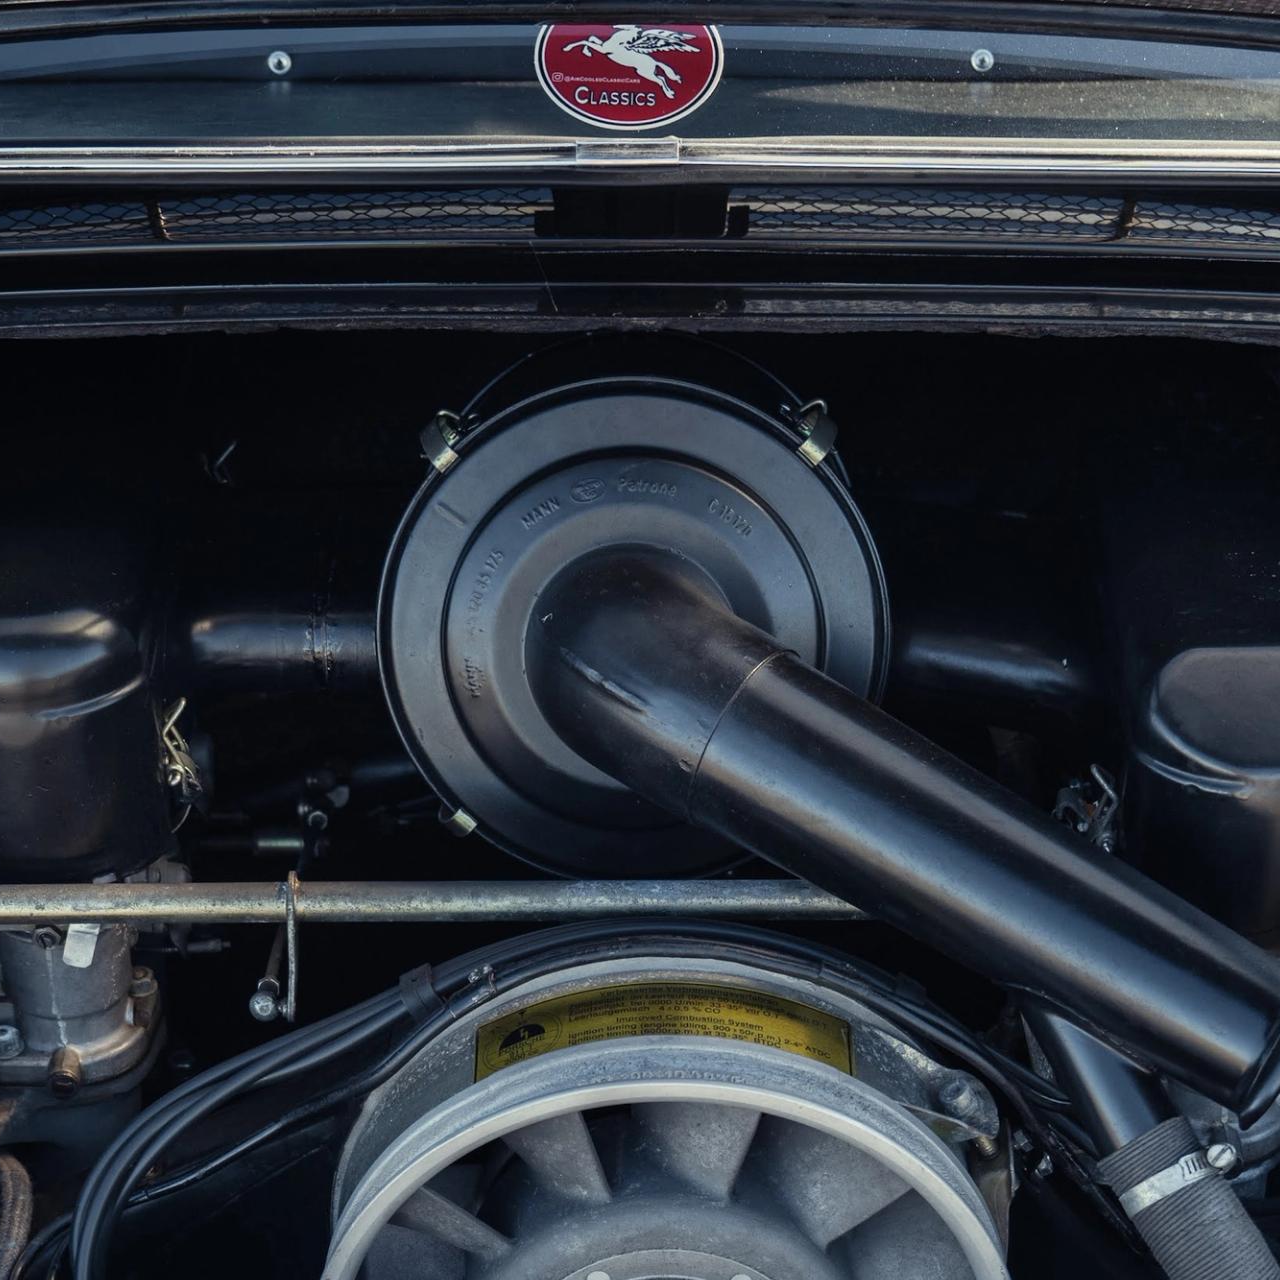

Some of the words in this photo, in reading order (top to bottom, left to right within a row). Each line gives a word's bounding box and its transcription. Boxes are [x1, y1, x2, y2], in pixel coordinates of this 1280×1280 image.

[521, 497, 561, 530] MANN
[616, 1014, 663, 1023] Improved
[665, 1014, 725, 1024] Combustion
[728, 1019, 764, 1031] System
[607, 1024, 637, 1033] timing
[804, 1045, 832, 1060] ATDC
